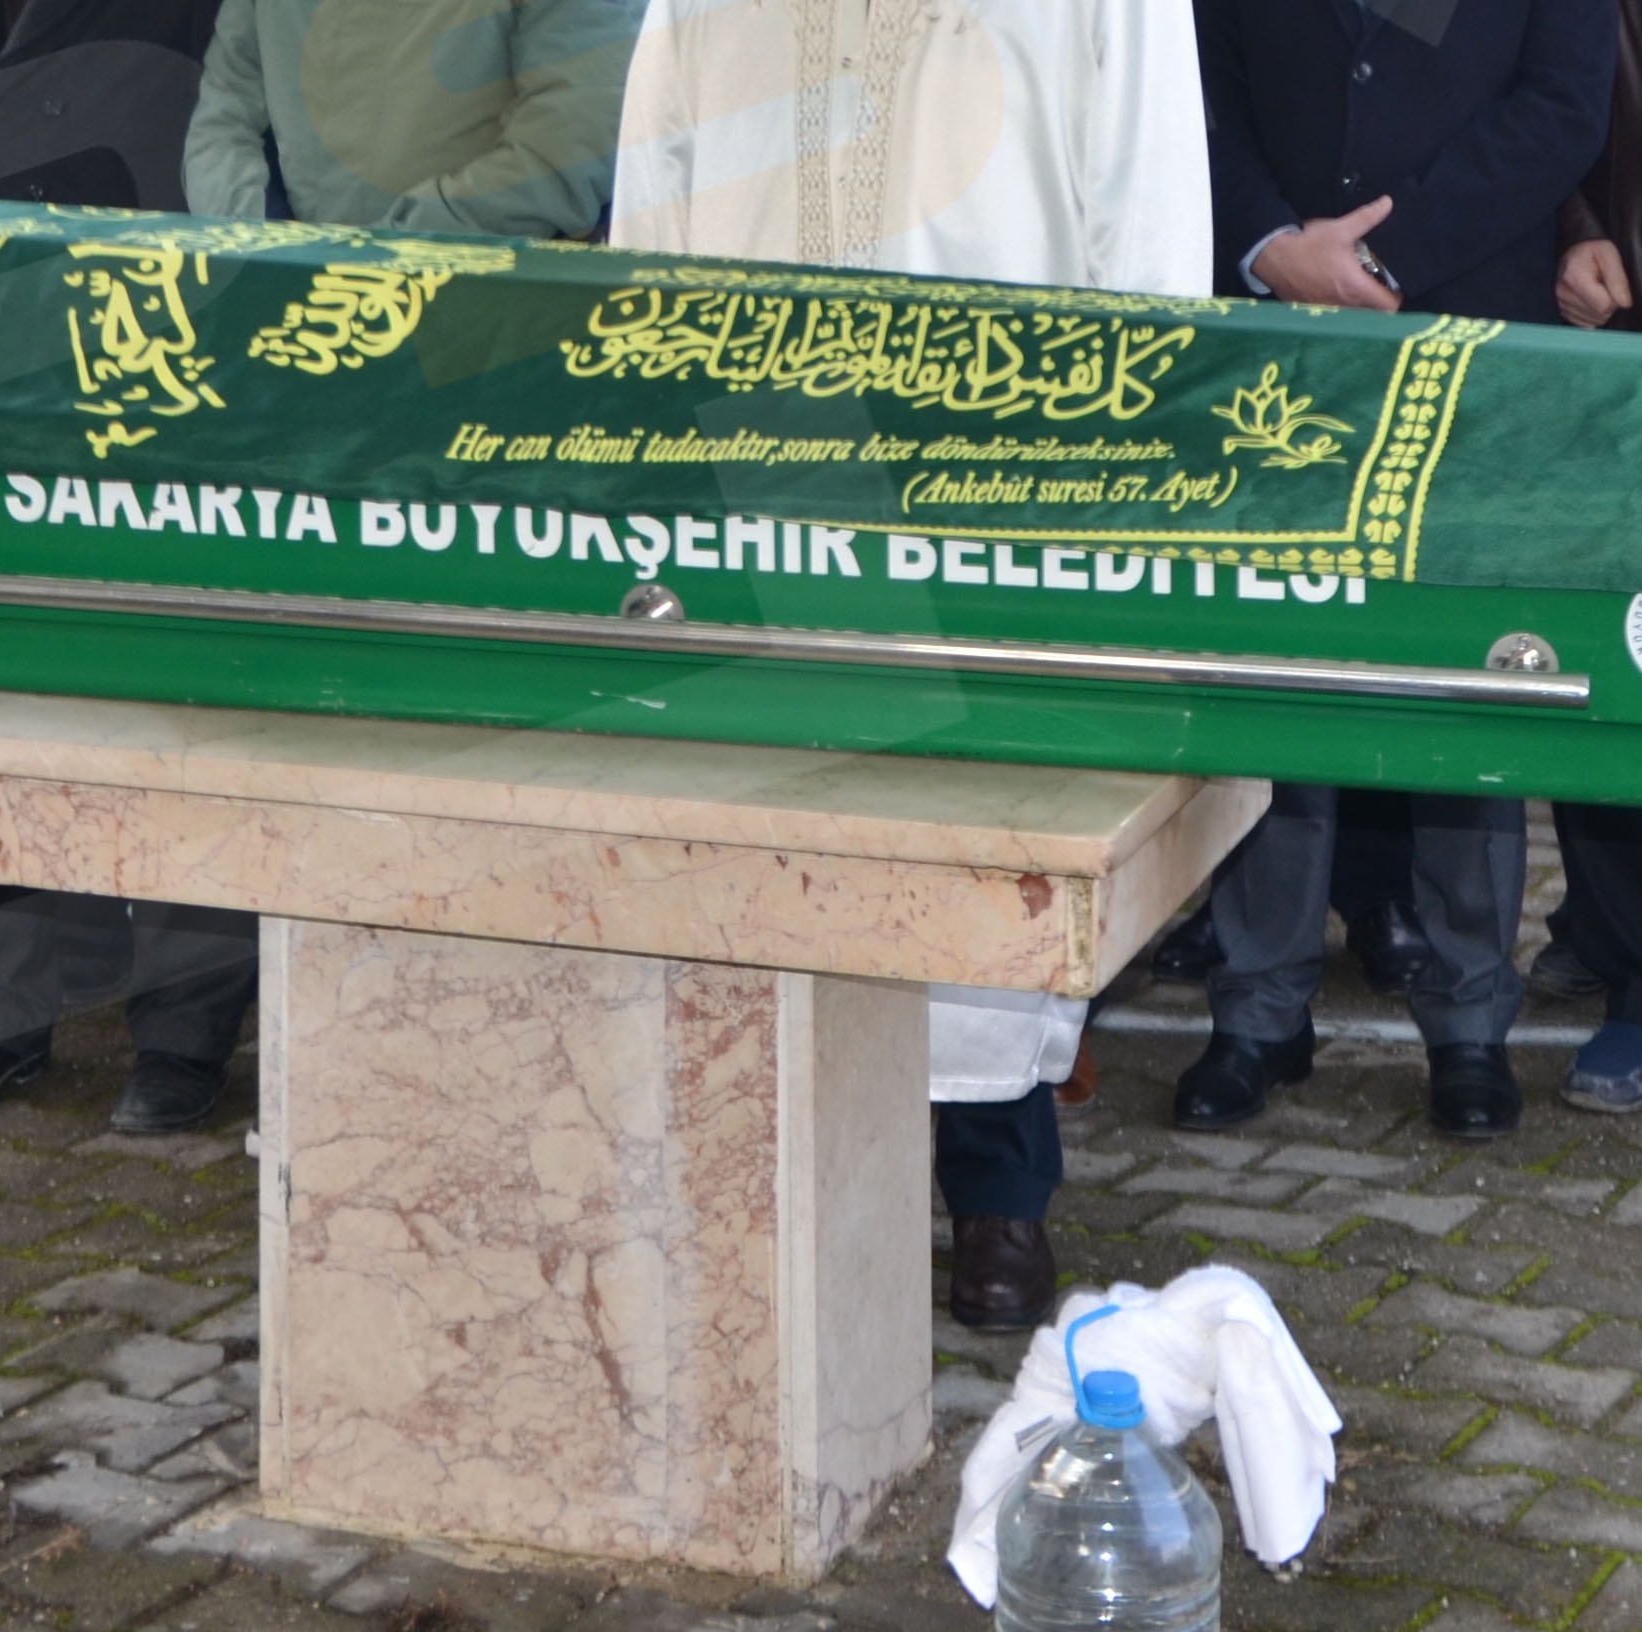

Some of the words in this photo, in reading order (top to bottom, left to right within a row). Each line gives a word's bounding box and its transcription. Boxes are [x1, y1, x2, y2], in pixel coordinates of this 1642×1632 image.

[445, 423, 506, 461] Her
[505, 432, 552, 461] can
[556, 424, 645, 463] ölümü
[4, 471, 338, 544] SAKARYA
[1036, 472, 1109, 504] suresi
[1107, 475, 1147, 502] 57.
